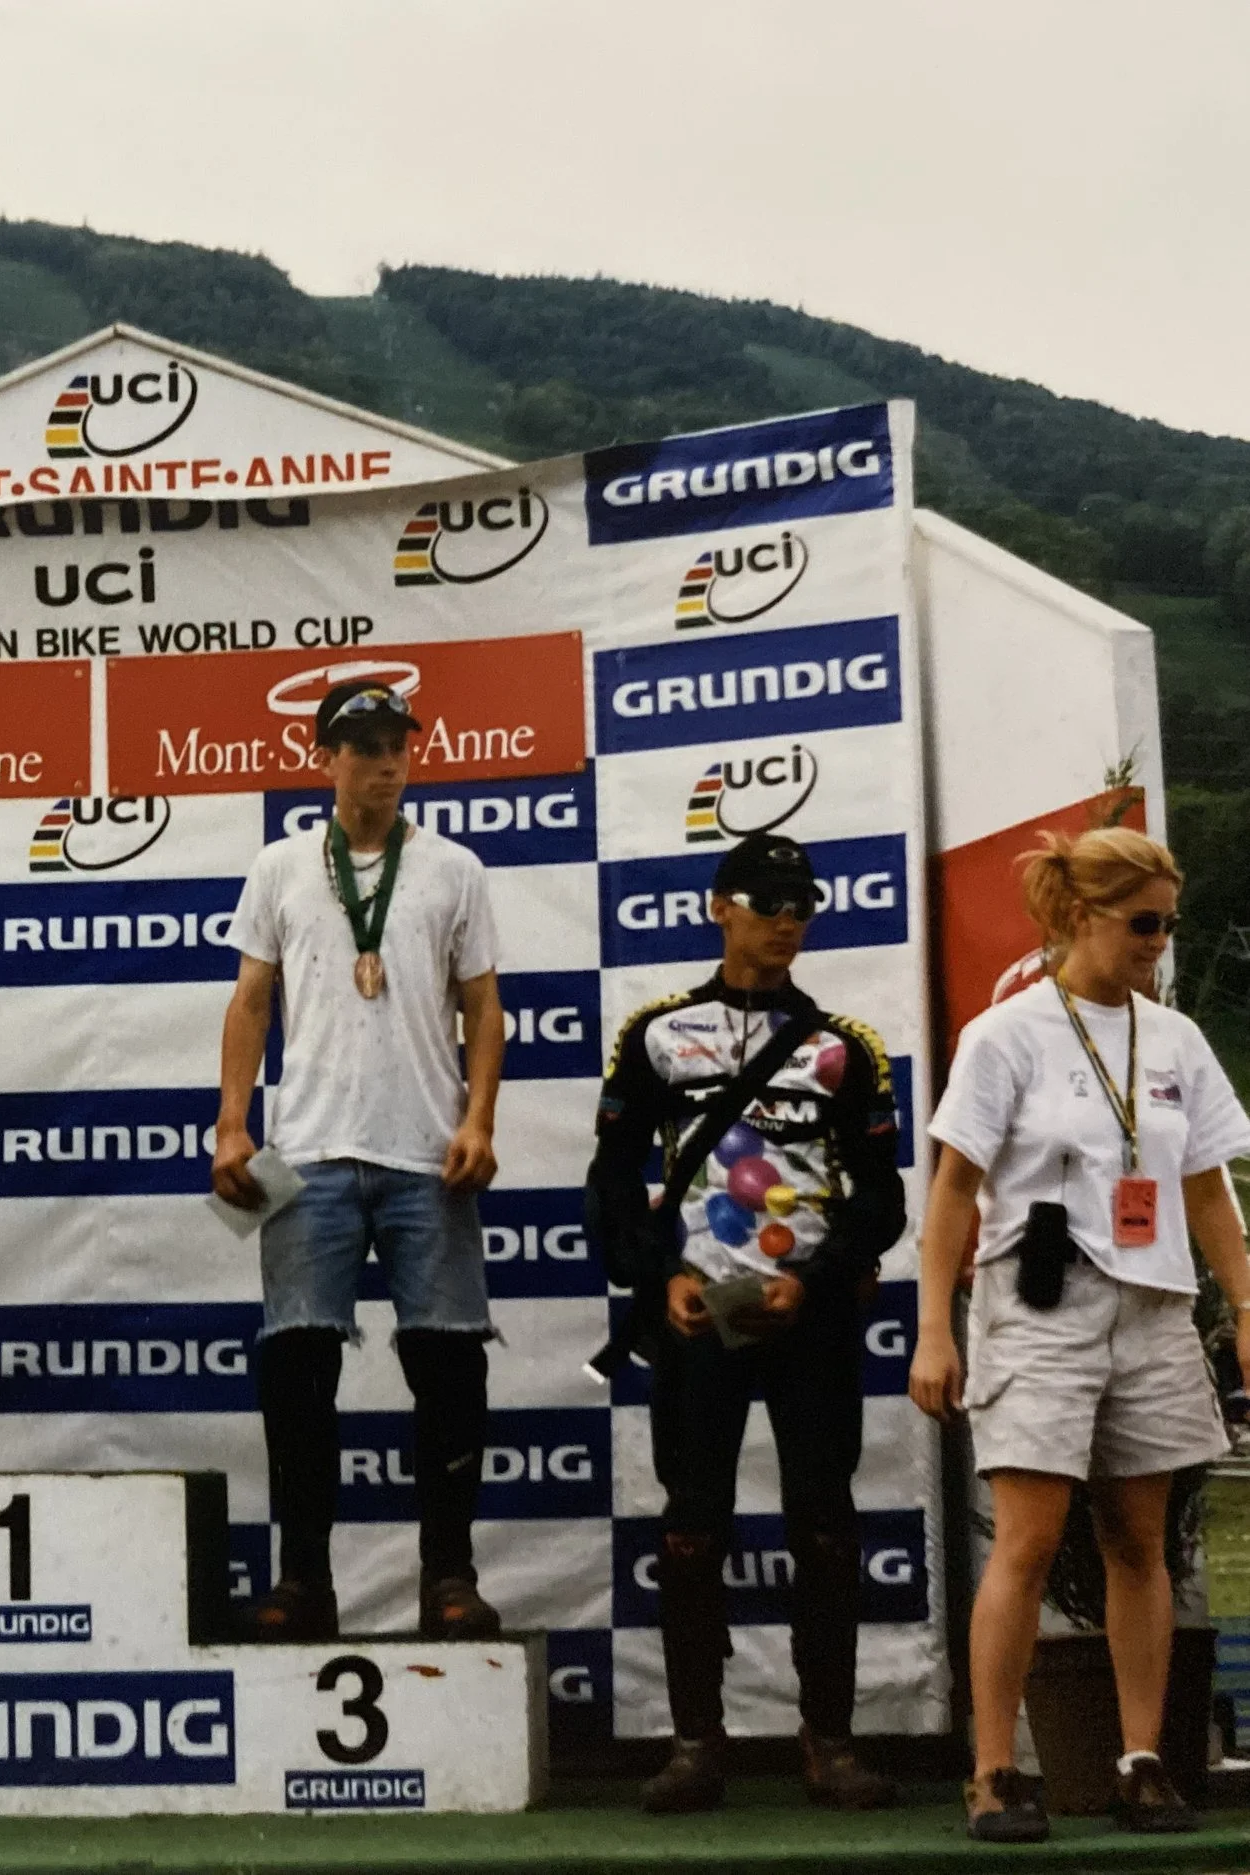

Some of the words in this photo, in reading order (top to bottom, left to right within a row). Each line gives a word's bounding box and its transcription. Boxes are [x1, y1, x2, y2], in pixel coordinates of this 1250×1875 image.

[603, 441, 881, 507] GRUNDIG
[36, 627, 121, 657] BIKE
[138, 620, 276, 655] WORLD
[295, 616, 373, 648] CUP
[612, 654, 888, 718] GRUNDIG
[316, 1655, 389, 1765] 3
[287, 1777, 423, 1801] GRUNDIG
